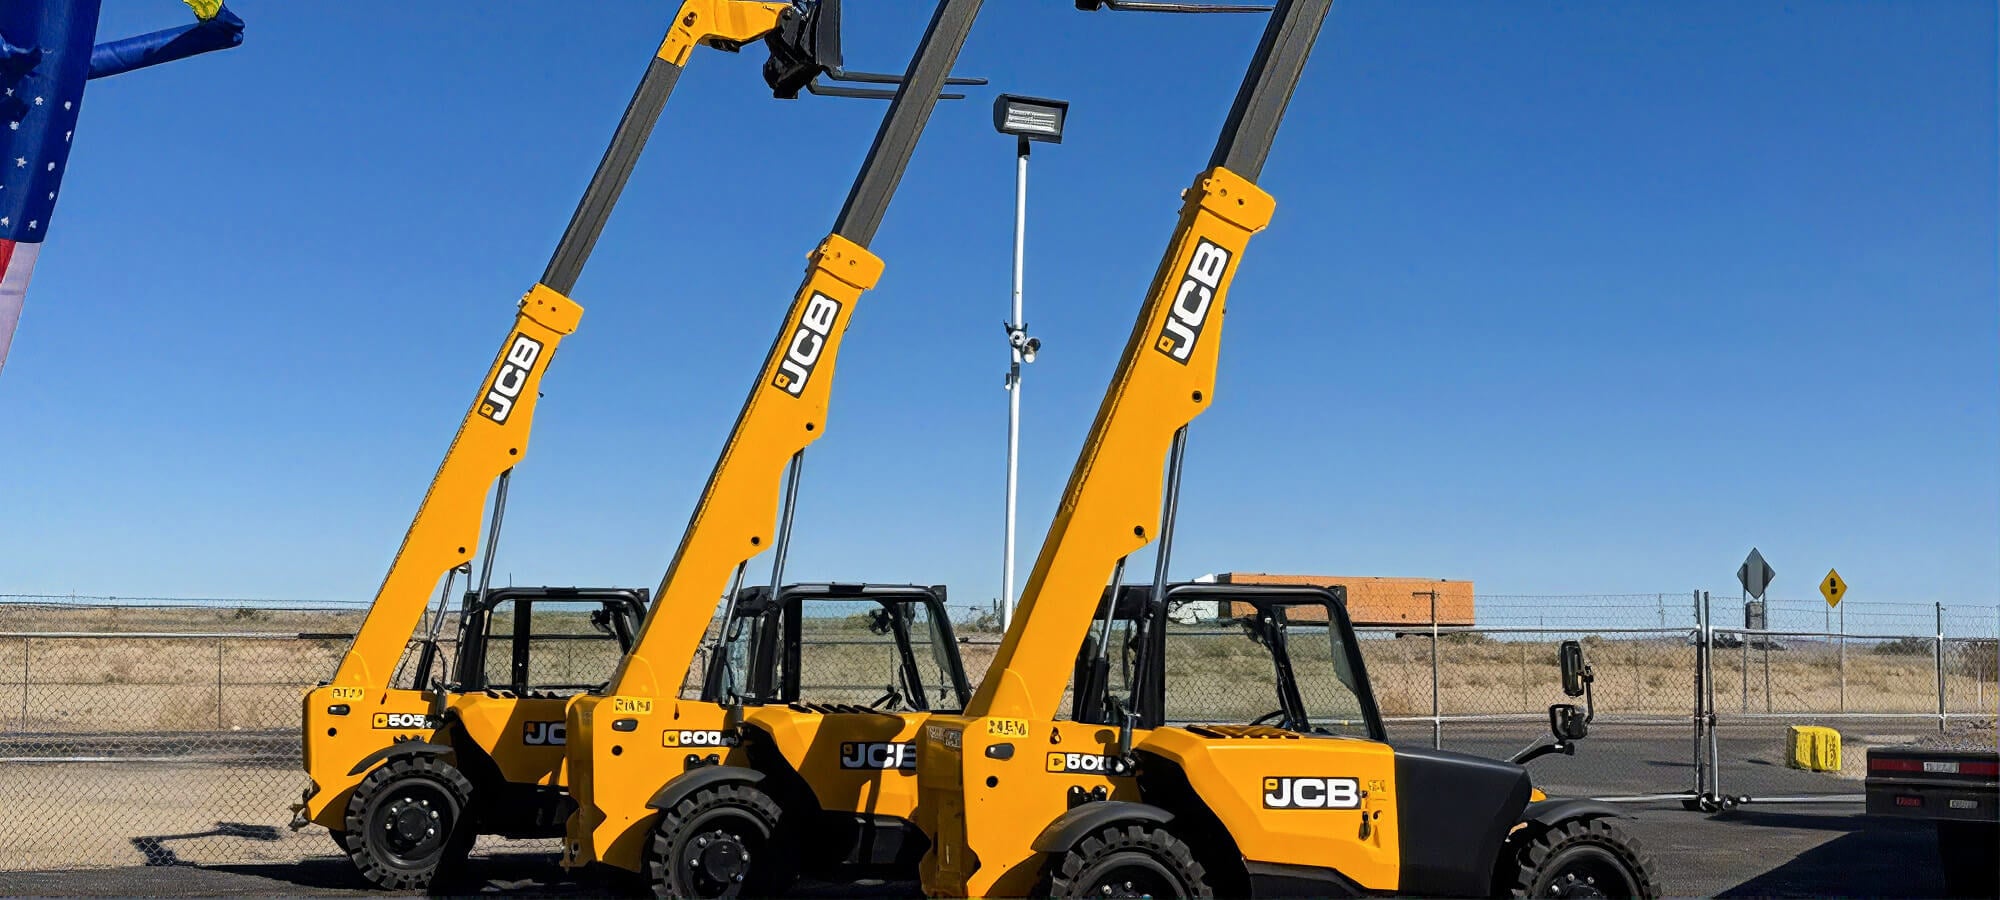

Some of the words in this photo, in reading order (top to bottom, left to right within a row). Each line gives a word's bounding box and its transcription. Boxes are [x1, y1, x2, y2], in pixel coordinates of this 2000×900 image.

[782, 294, 838, 393] JCB
[1166, 242, 1228, 360] JCB
[488, 336, 540, 422] JCB
[525, 722, 566, 745] JC
[1265, 778, 1359, 808] JCB
